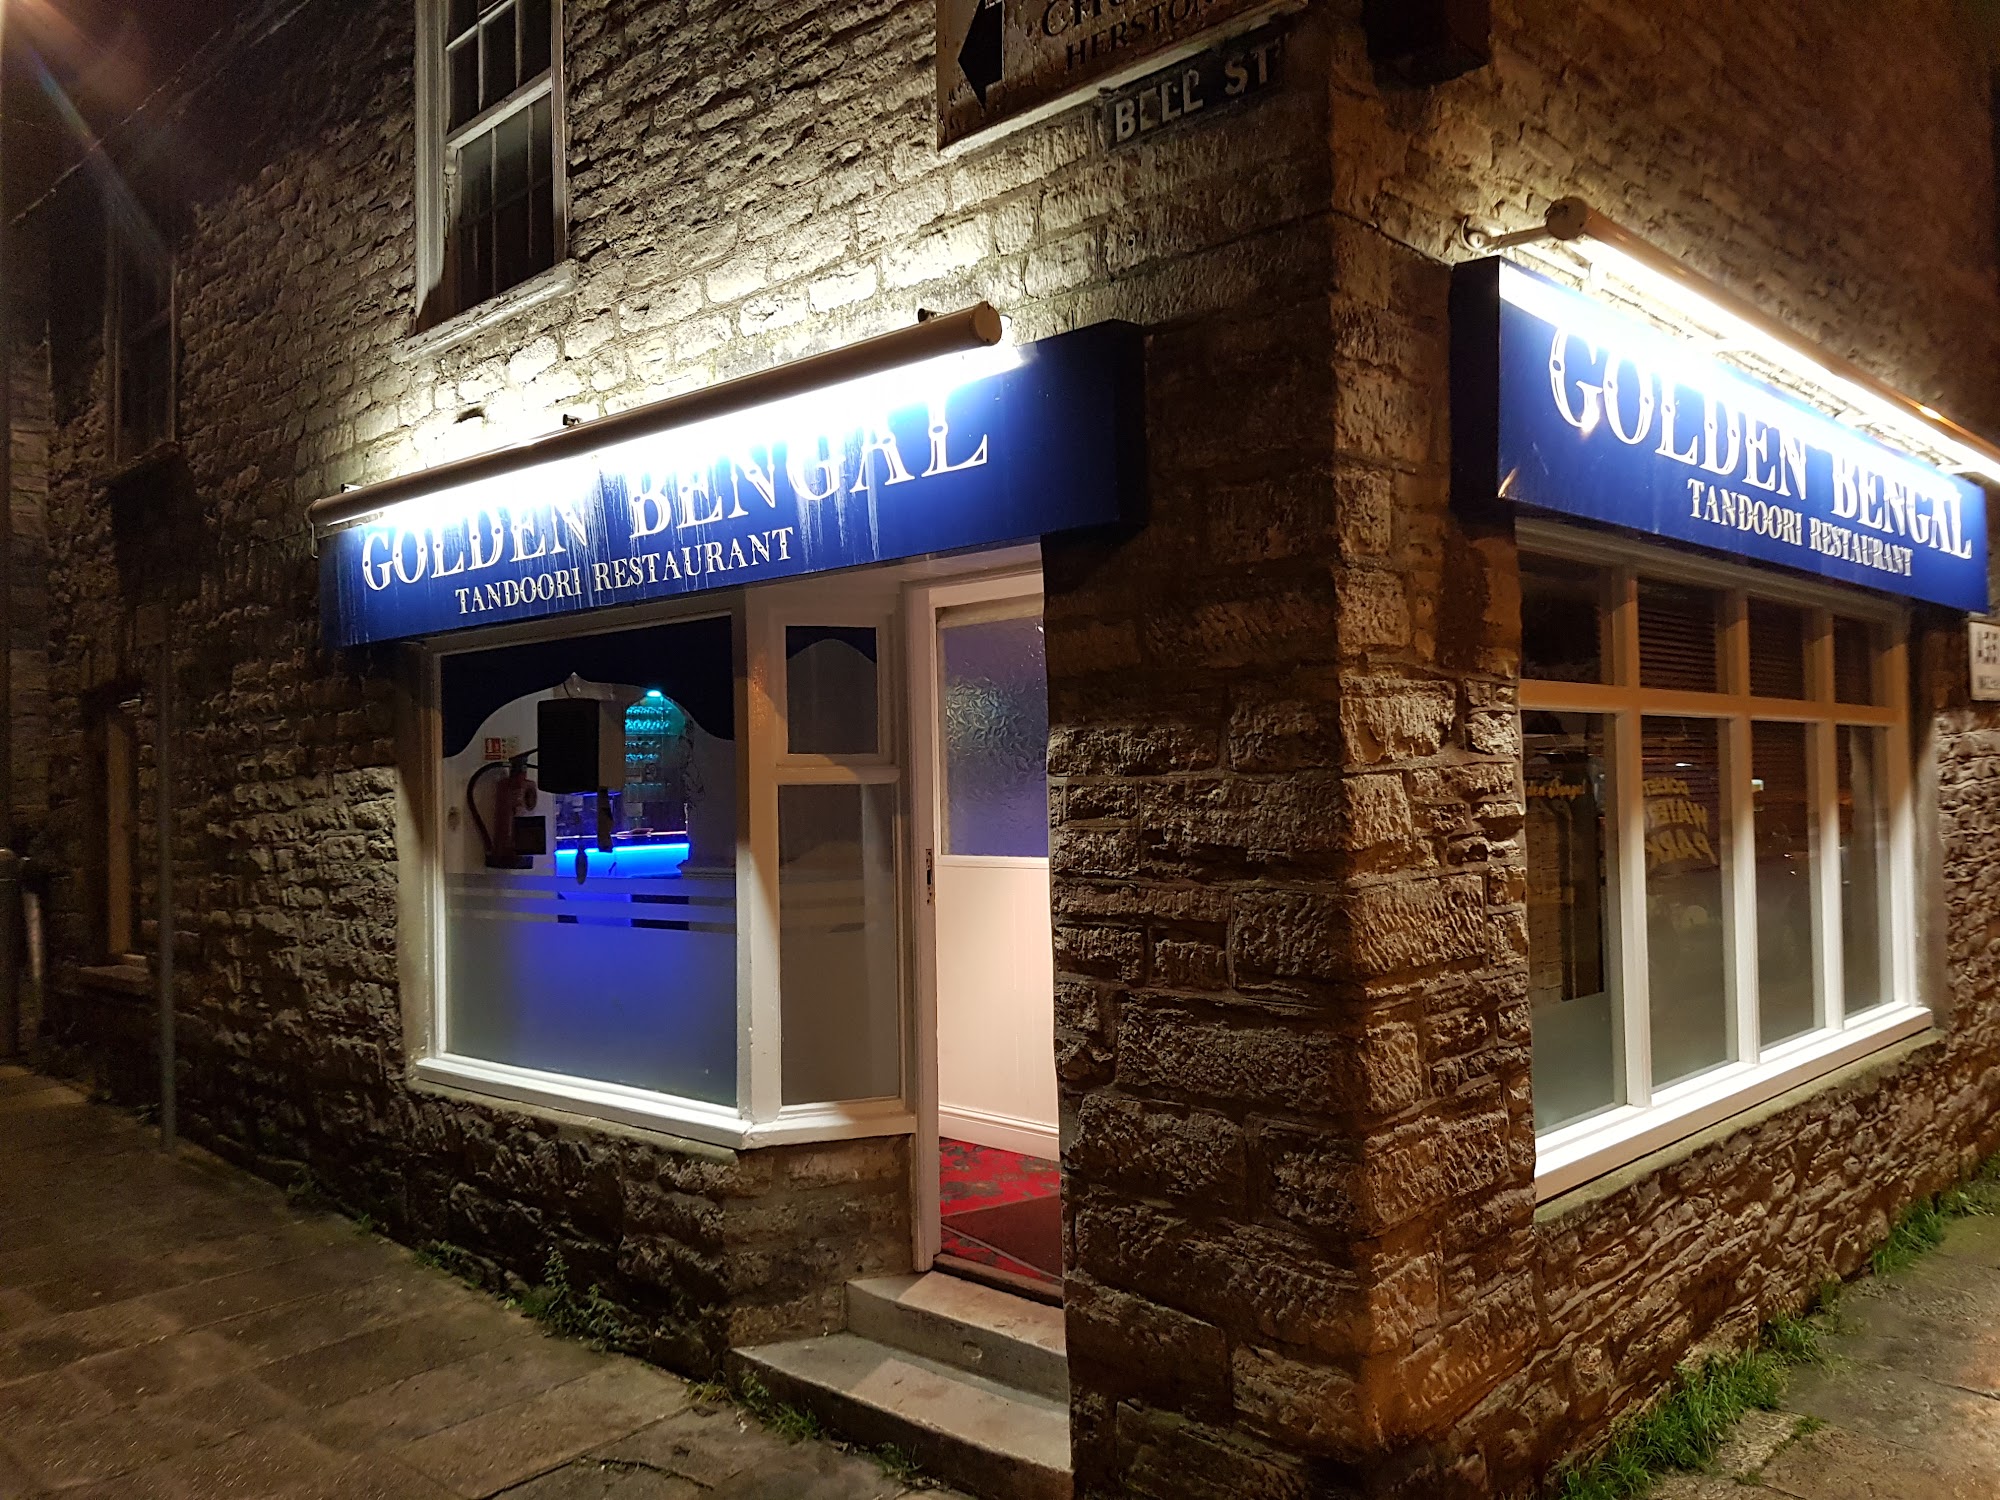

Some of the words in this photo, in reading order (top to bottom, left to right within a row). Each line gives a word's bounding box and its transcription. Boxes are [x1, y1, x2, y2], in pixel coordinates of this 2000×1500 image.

[1224, 36, 1282, 96] ST
[1548, 316, 1808, 499] GOLDEN
[1831, 447, 1972, 560] BENGAL
[362, 490, 592, 593] GOLDEN
[629, 394, 989, 537] BENGAL
[1688, 478, 1804, 546] TANDOORI
[1809, 517, 1914, 577] RESTAURANT
[455, 568, 583, 615] TANDOORI
[594, 528, 795, 593] RESTAURANT
